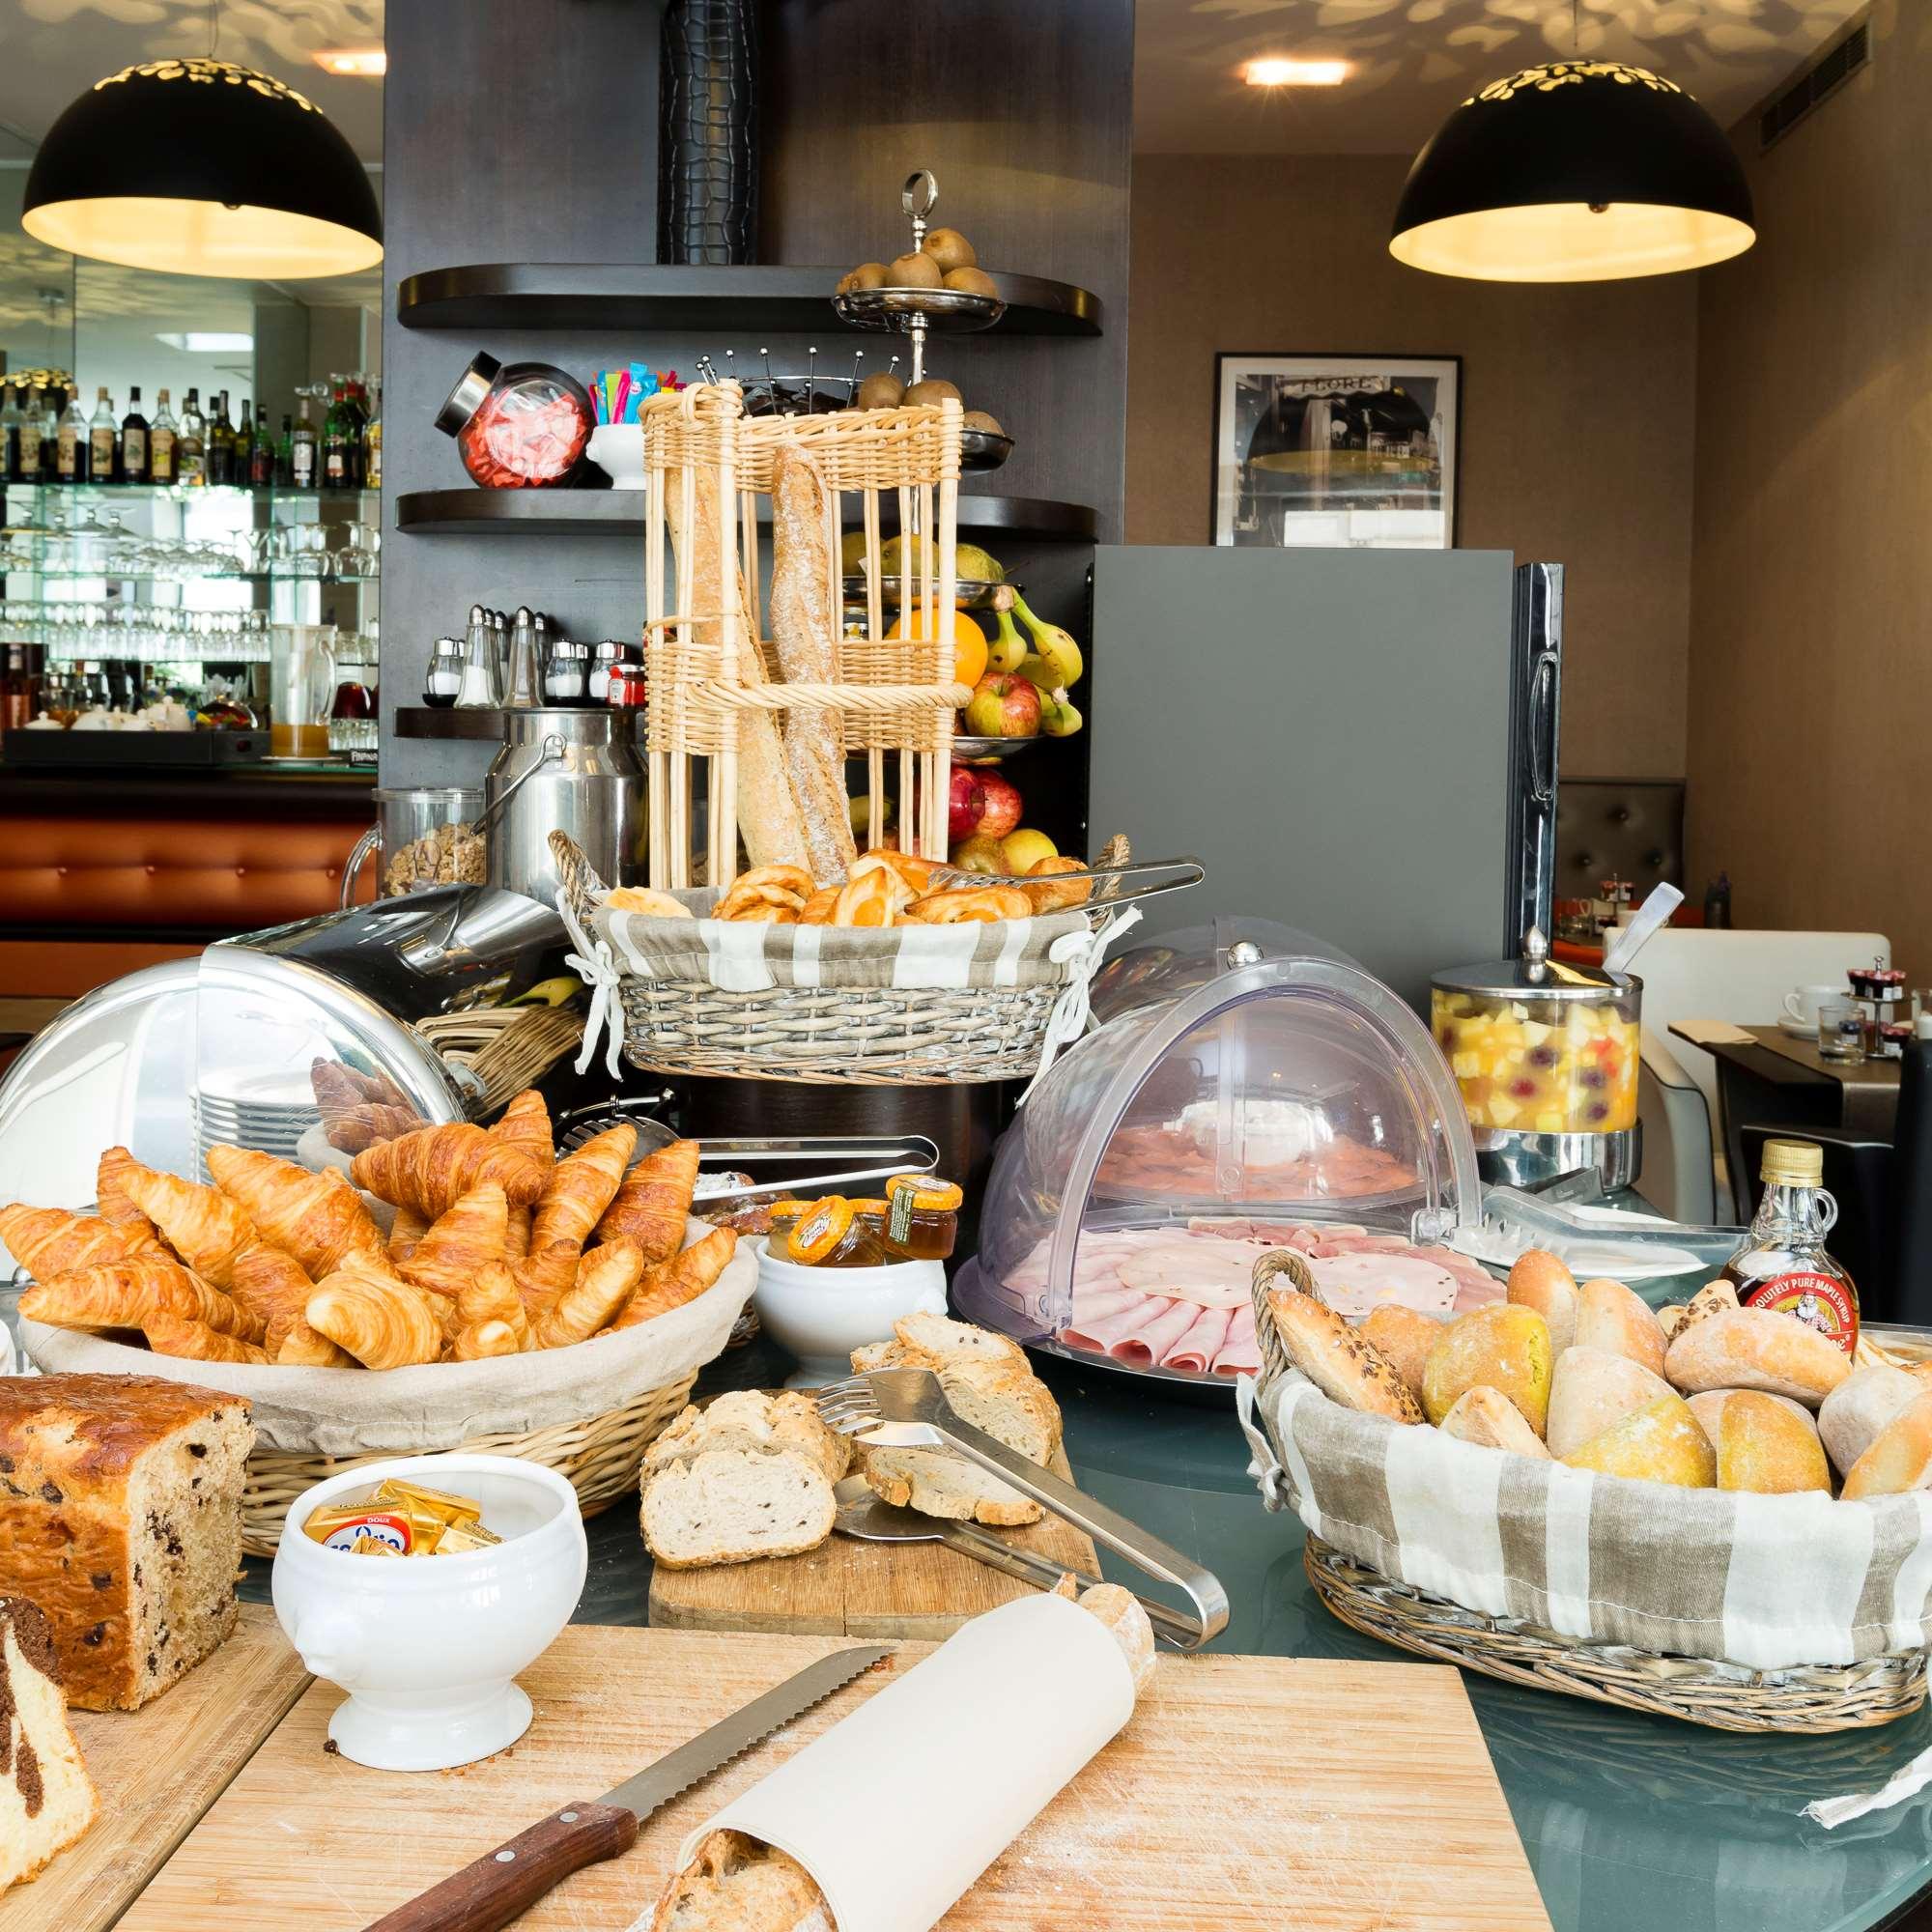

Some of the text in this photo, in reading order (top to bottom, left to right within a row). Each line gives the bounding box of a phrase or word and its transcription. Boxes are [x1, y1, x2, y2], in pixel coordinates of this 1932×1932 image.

[1752, 1277, 1851, 1324] OLUTELY PURE MAPLE SYRUP
